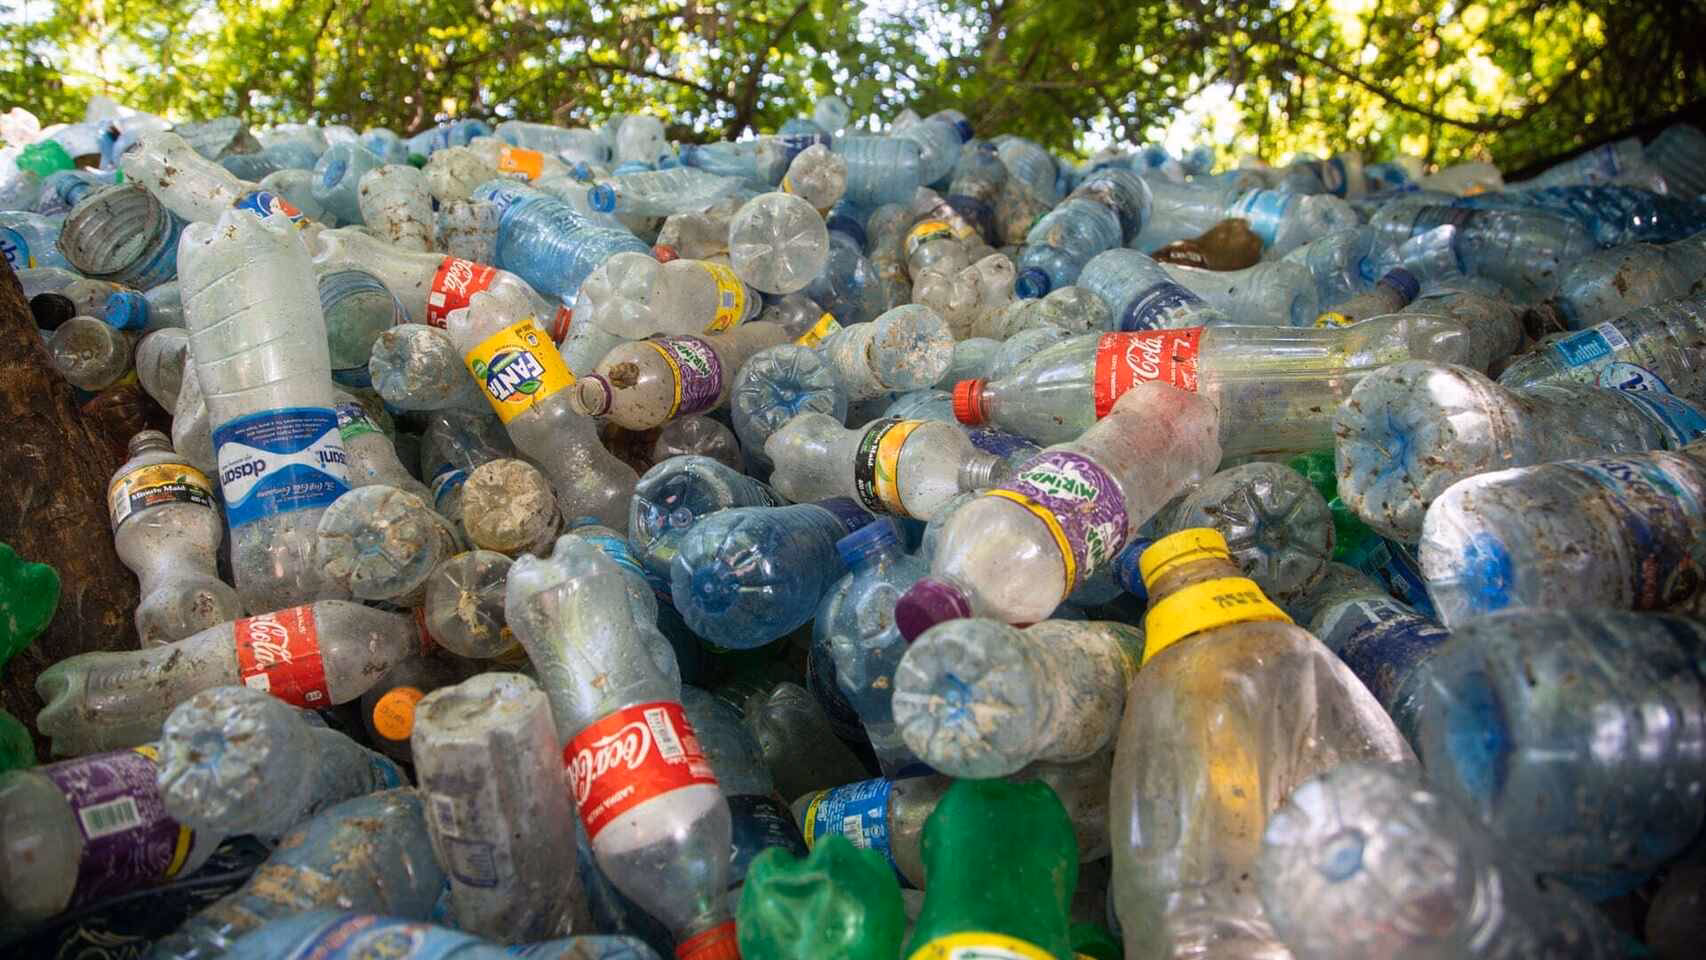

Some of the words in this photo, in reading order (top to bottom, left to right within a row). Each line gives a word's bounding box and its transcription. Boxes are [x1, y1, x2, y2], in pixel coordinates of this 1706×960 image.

[487, 350, 545, 401] FANTA
[221, 457, 266, 486] dasan
[319, 450, 347, 469] sani
[567, 721, 651, 808] Coca-Col
